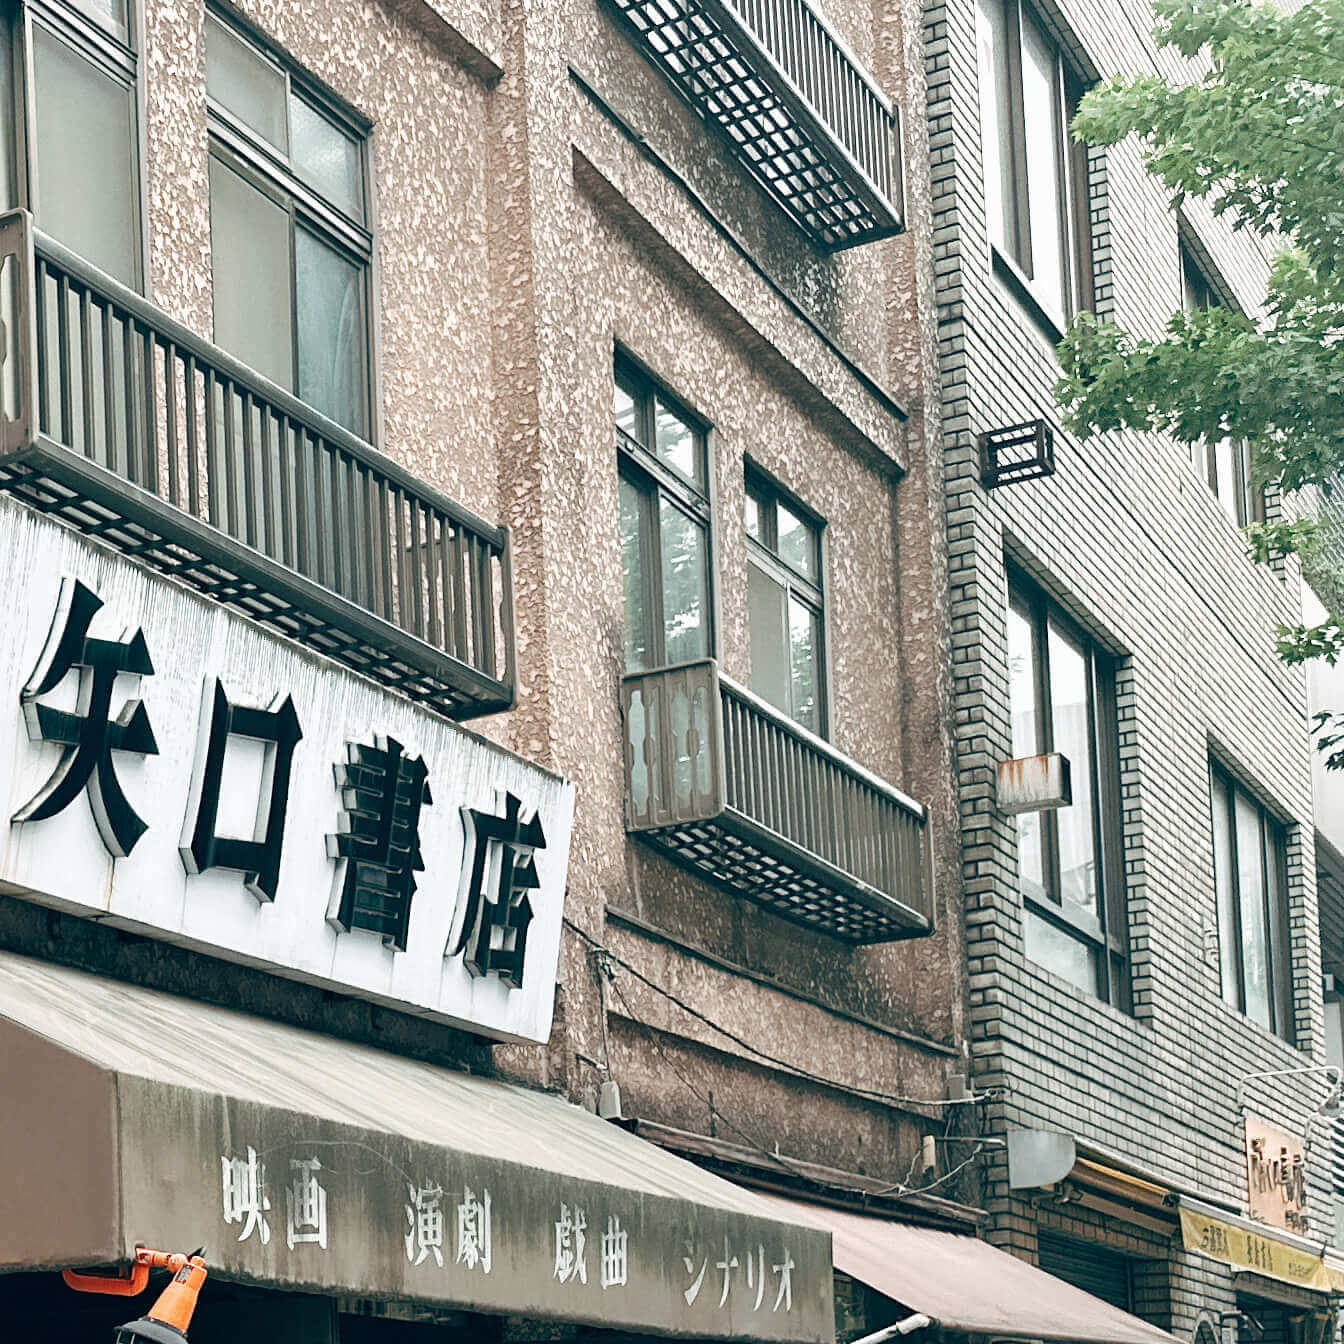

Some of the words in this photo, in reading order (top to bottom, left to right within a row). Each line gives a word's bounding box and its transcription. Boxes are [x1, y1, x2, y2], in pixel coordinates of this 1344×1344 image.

[12, 576, 547, 988] 矢口書店
[221, 1145, 328, 1251] 映画
[405, 1180, 492, 1275] 演劇
[553, 1202, 630, 1290] 戯曲
[682, 1245, 796, 1313] シナリオ
